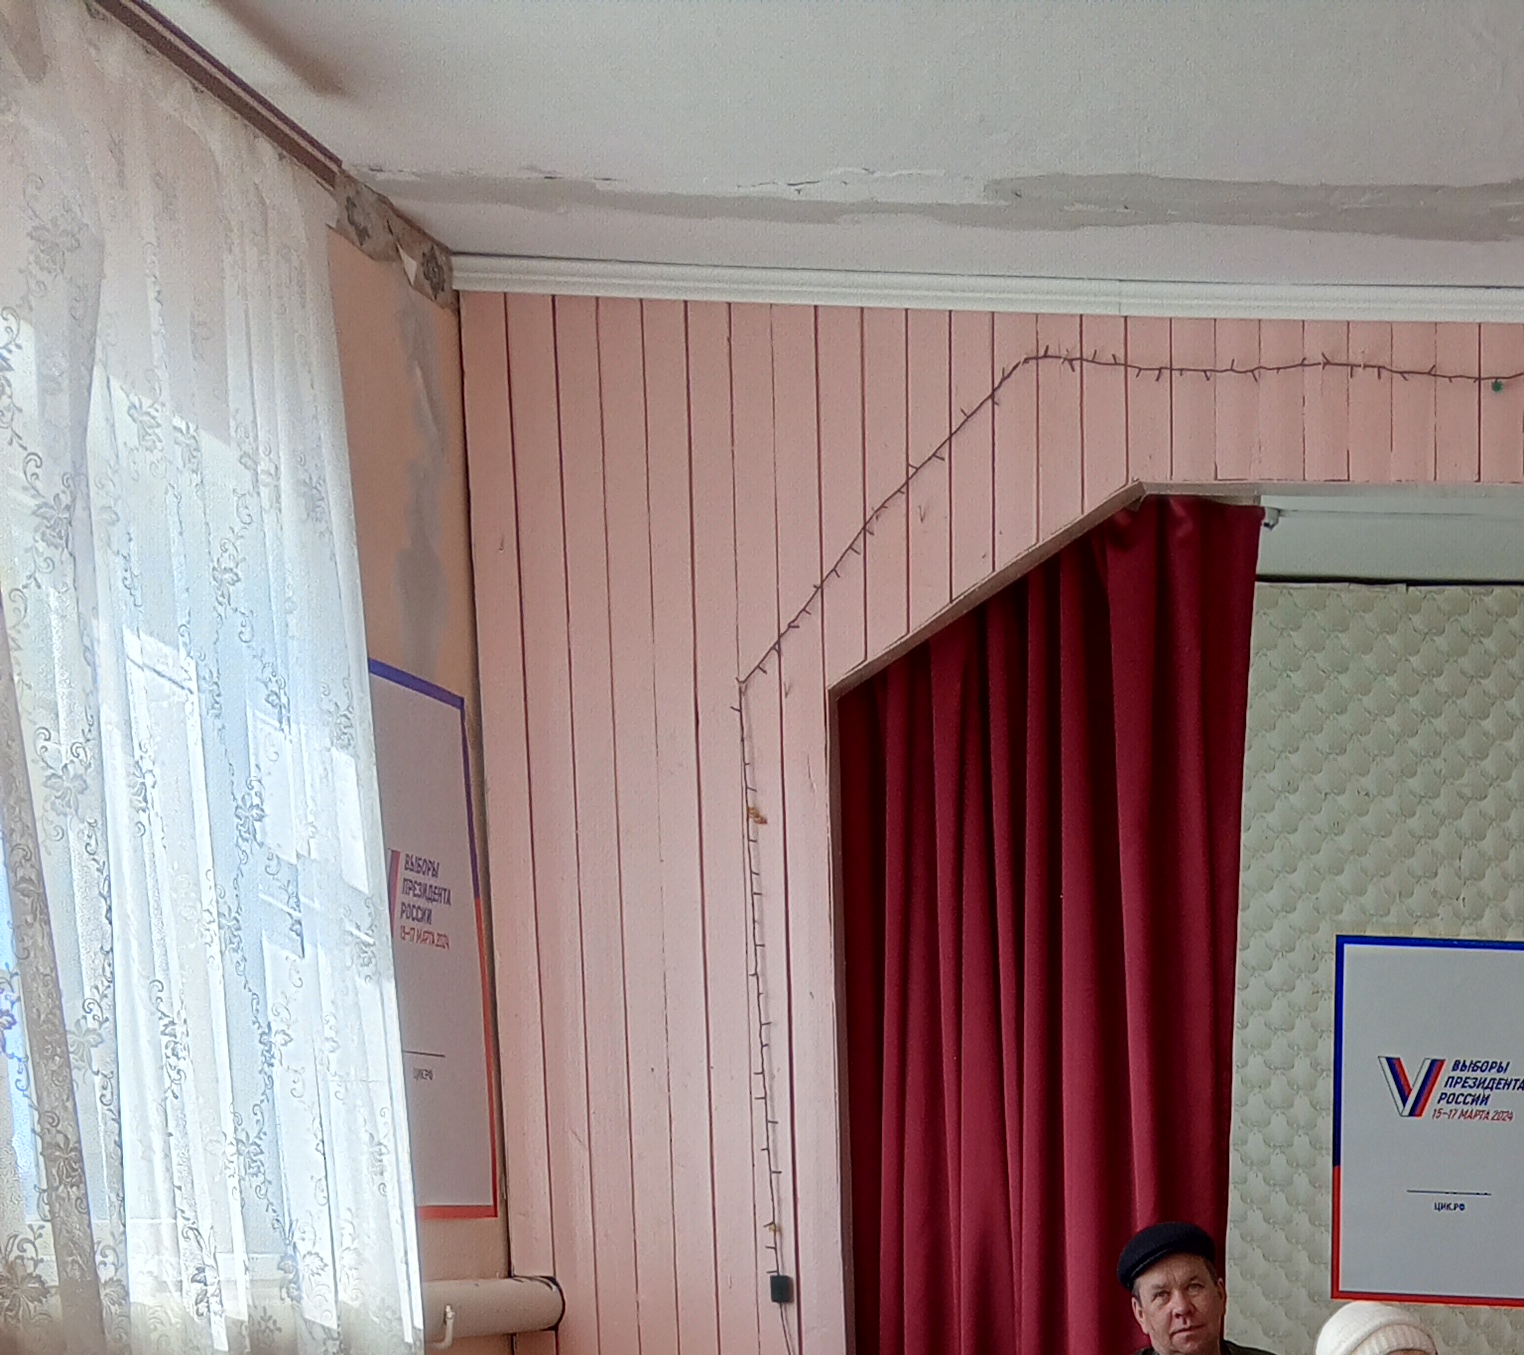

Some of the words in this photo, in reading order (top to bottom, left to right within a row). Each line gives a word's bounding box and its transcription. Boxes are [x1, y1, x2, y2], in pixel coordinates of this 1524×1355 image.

[403, 853, 440, 878] ВЫБОРЫ
[402, 877, 452, 906] ПРЕЗИДЕНТА
[400, 902, 433, 925] РОССИИ
[1451, 1059, 1511, 1074] ВЫБОРЫ
[1437, 1092, 1491, 1106] РОССИИ
[1458, 1109, 1490, 1121] МАРТА
[1491, 1110, 1514, 1122] 2024
[1434, 1202, 1466, 1212] ЦИК.РФ
